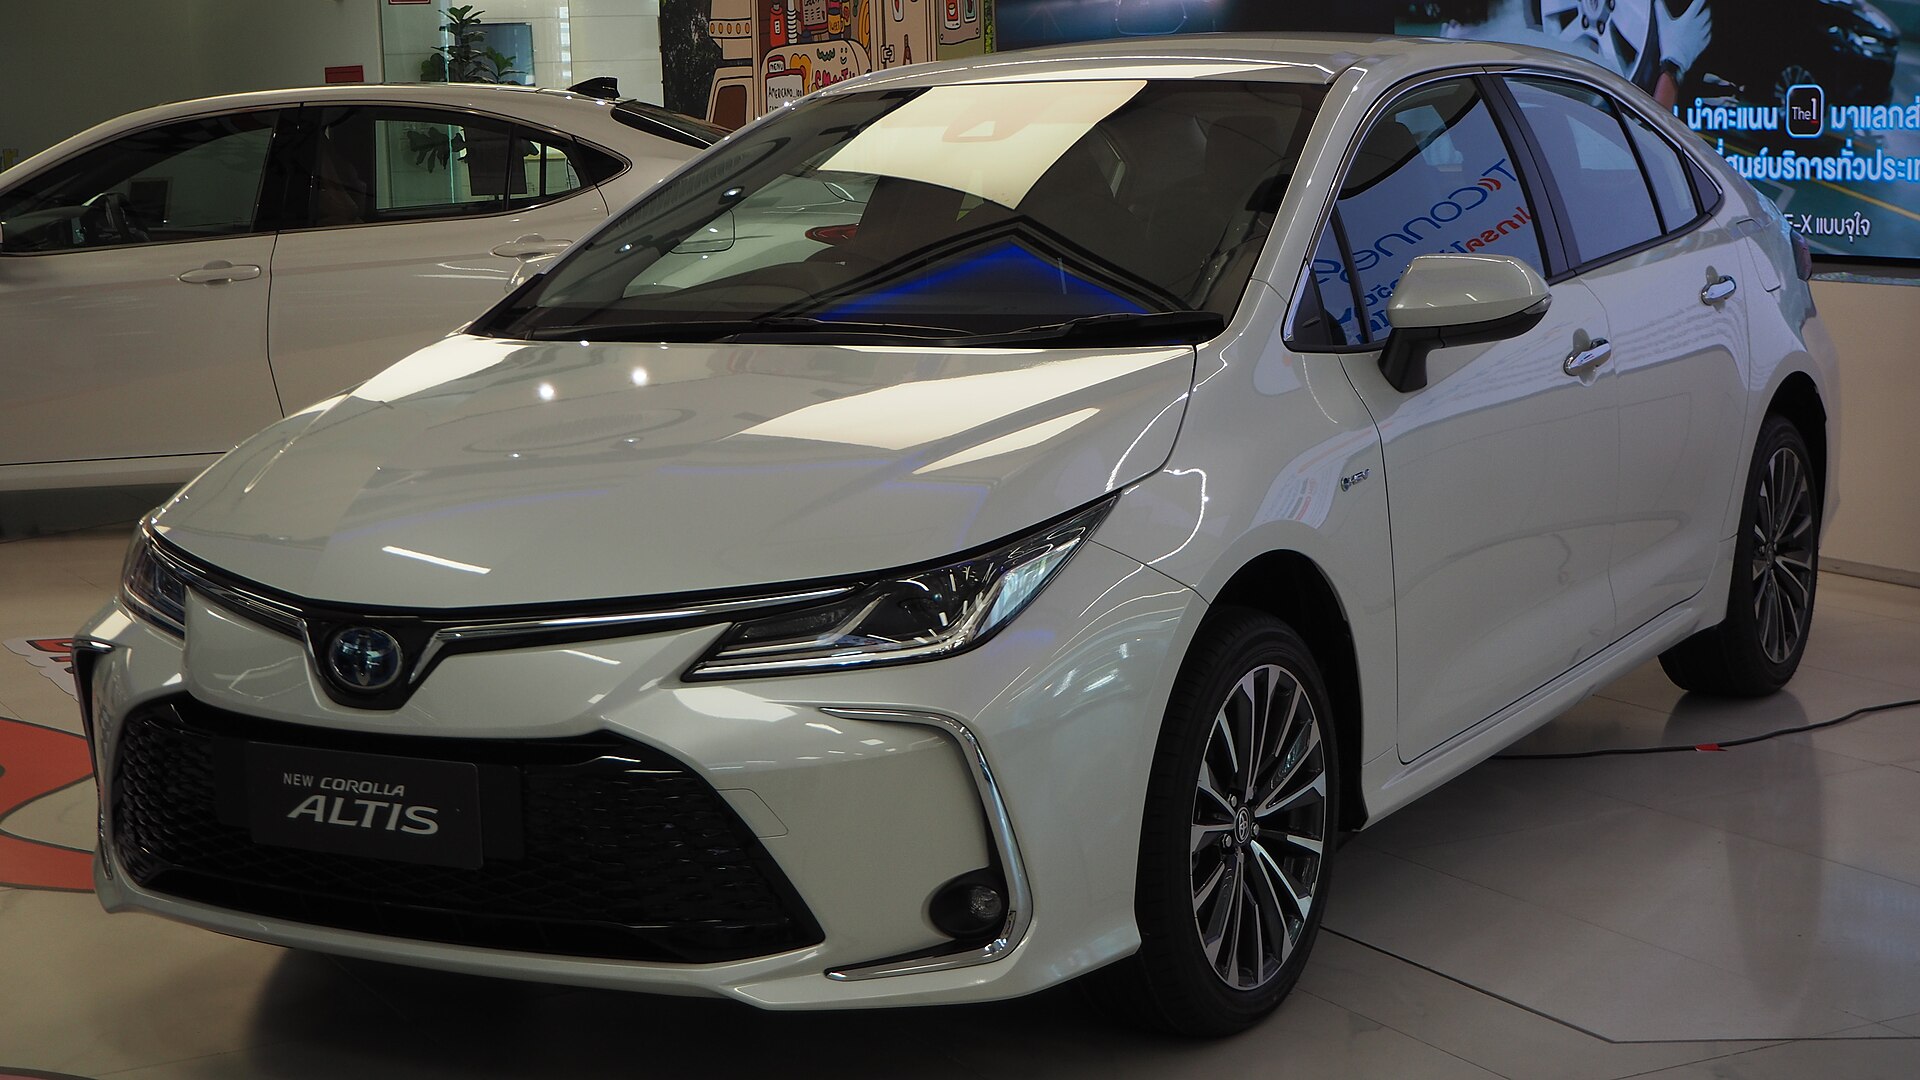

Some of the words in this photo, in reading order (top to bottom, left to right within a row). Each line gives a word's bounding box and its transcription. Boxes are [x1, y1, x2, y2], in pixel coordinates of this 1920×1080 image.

[1686, 97, 1778, 131] นำคะแนน
[1816, 211, 1871, 242] แบบจุใจ
[283, 772, 314, 787] NEW
[319, 776, 405, 797] COROLLA
[286, 793, 440, 836] ALTIS
